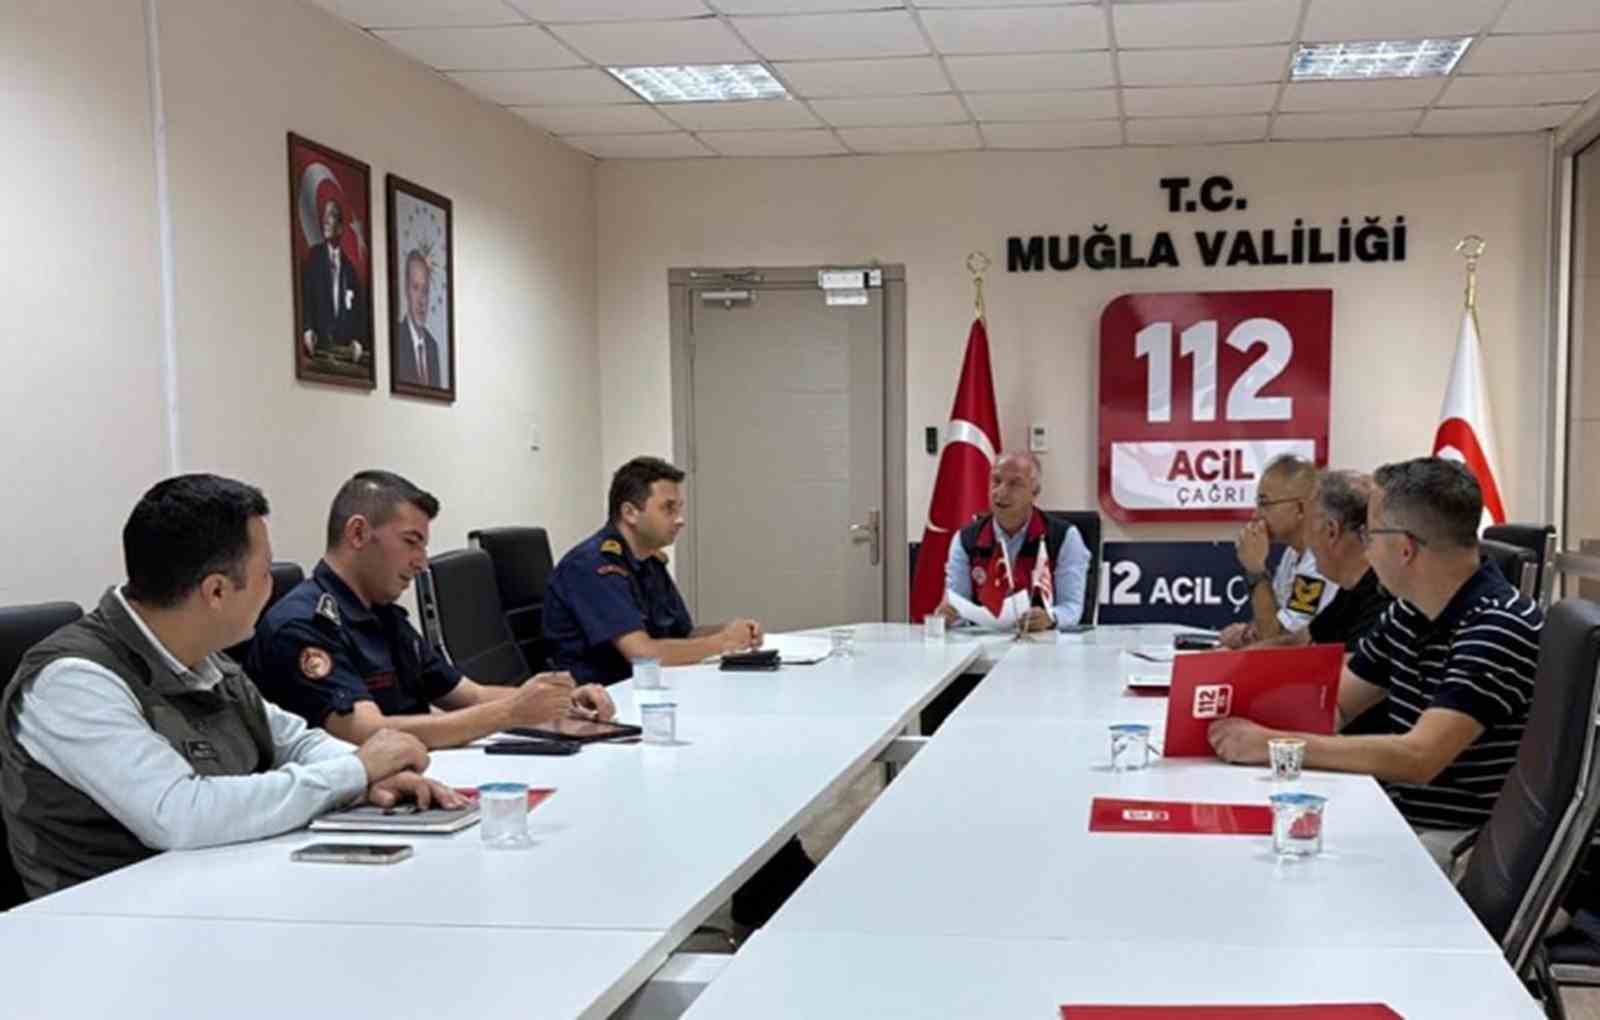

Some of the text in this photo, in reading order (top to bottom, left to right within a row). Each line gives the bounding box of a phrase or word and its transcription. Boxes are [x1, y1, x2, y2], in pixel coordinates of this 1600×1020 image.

[1160, 175, 1248, 212] T.C.
[1007, 215, 1407, 273] MUĞLA VALİLİĞİ
[1134, 317, 1294, 423] 112
[1176, 484, 1246, 505] ÇAĞRI
[1099, 560, 1141, 605] 12
[1226, 575, 1249, 613] Ç
[1198, 689, 1217, 713] 112
